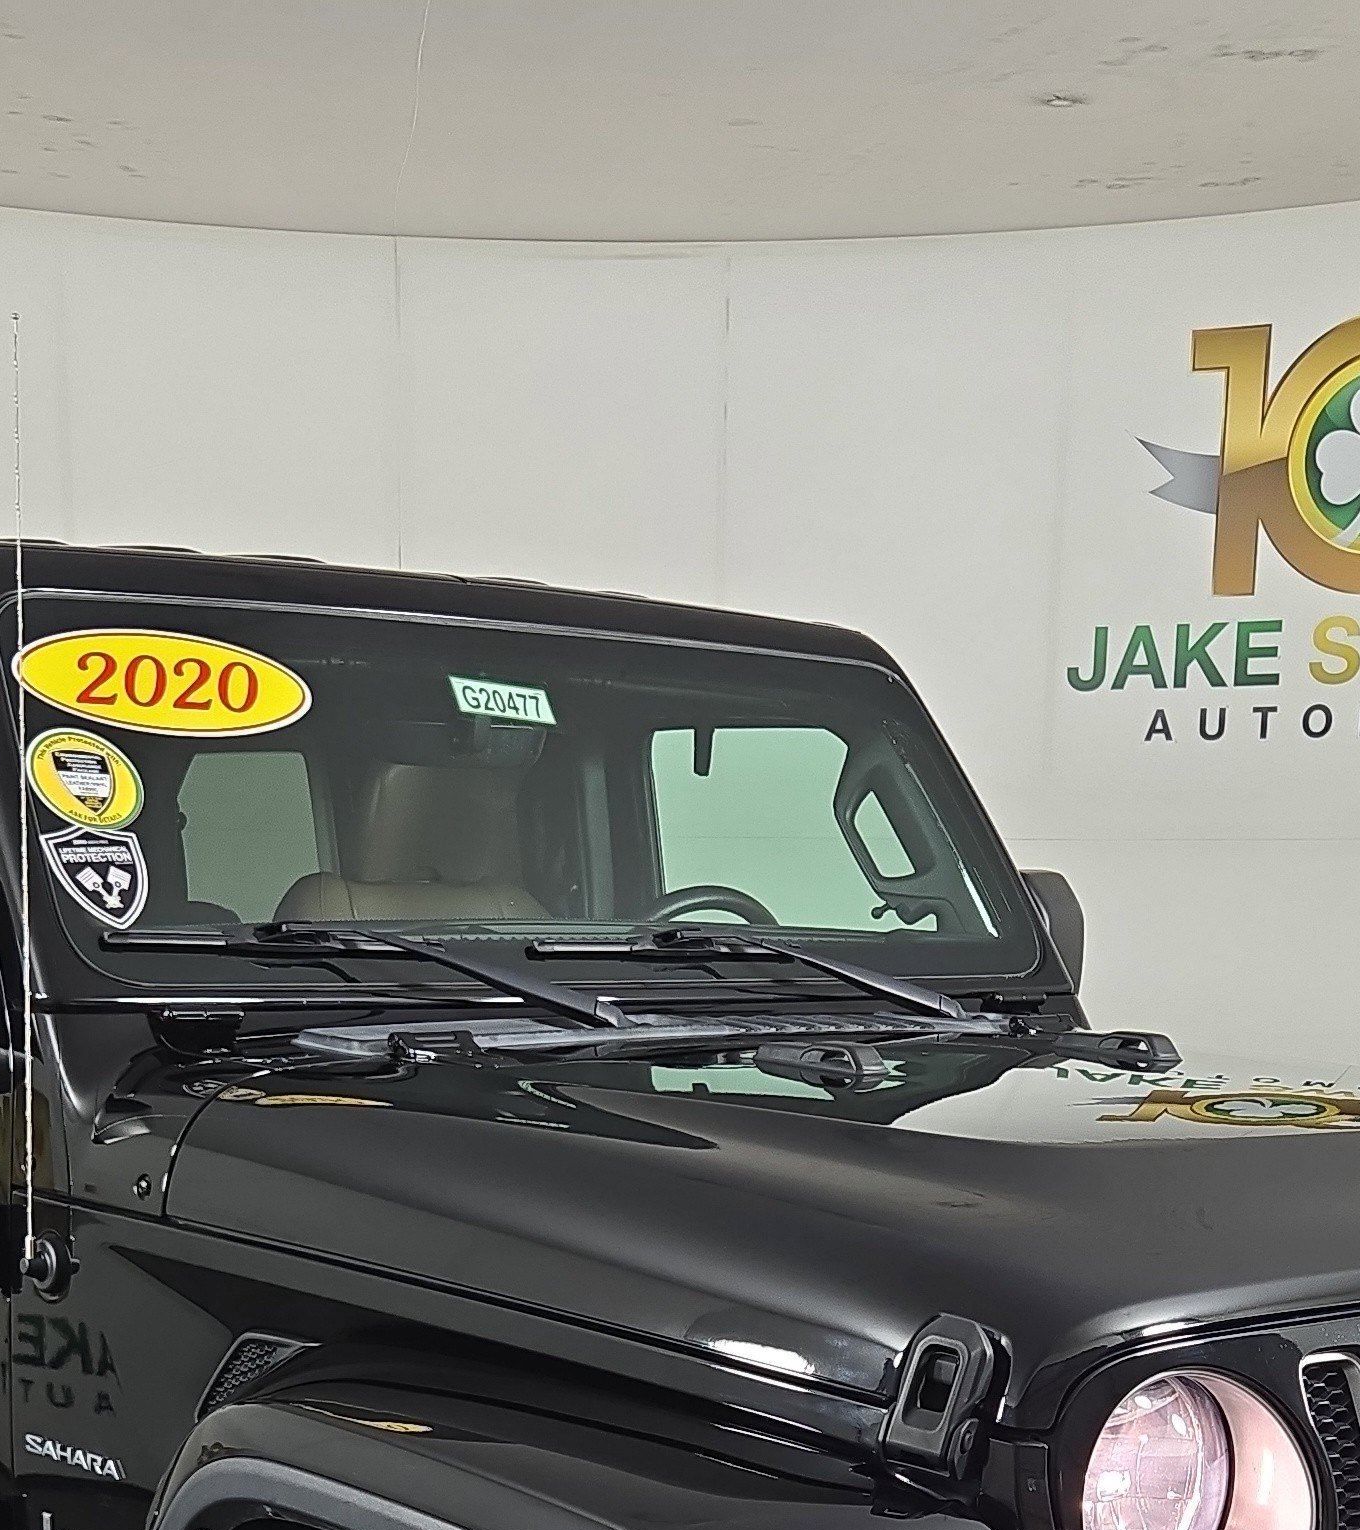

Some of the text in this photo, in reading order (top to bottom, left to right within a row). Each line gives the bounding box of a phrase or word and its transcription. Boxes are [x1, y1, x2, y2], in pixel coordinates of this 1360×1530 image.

[1066, 618, 1284, 693] JAKE
[76, 651, 260, 713] 2020
[462, 685, 540, 719] G20477
[60, 852, 133, 863] PROTECTION
[24, 1433, 120, 1481] SAHARA
